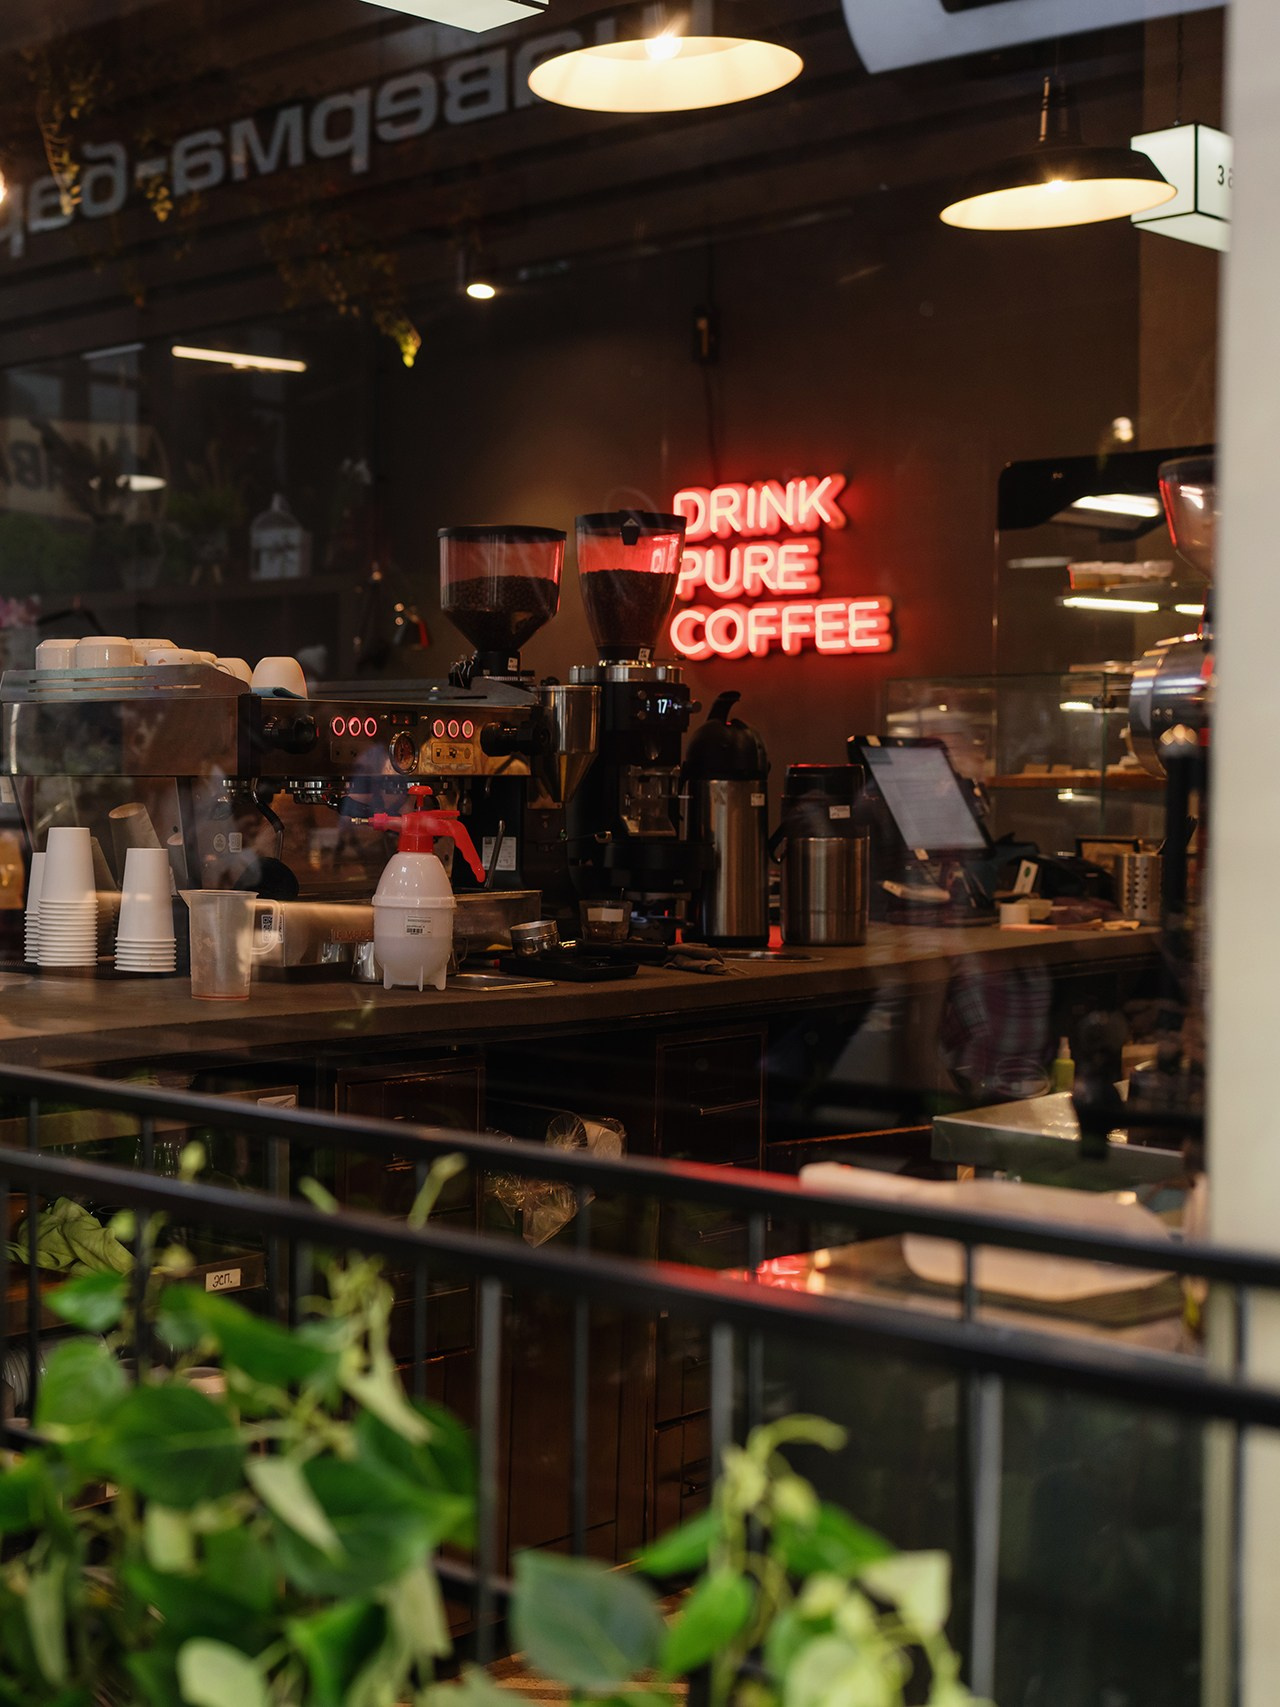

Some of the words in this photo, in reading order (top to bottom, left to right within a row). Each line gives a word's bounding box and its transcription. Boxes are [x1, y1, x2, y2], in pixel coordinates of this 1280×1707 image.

[673, 474, 844, 540] DRINK
[676, 540, 819, 600] PURE
[670, 598, 891, 660] COFFEE
